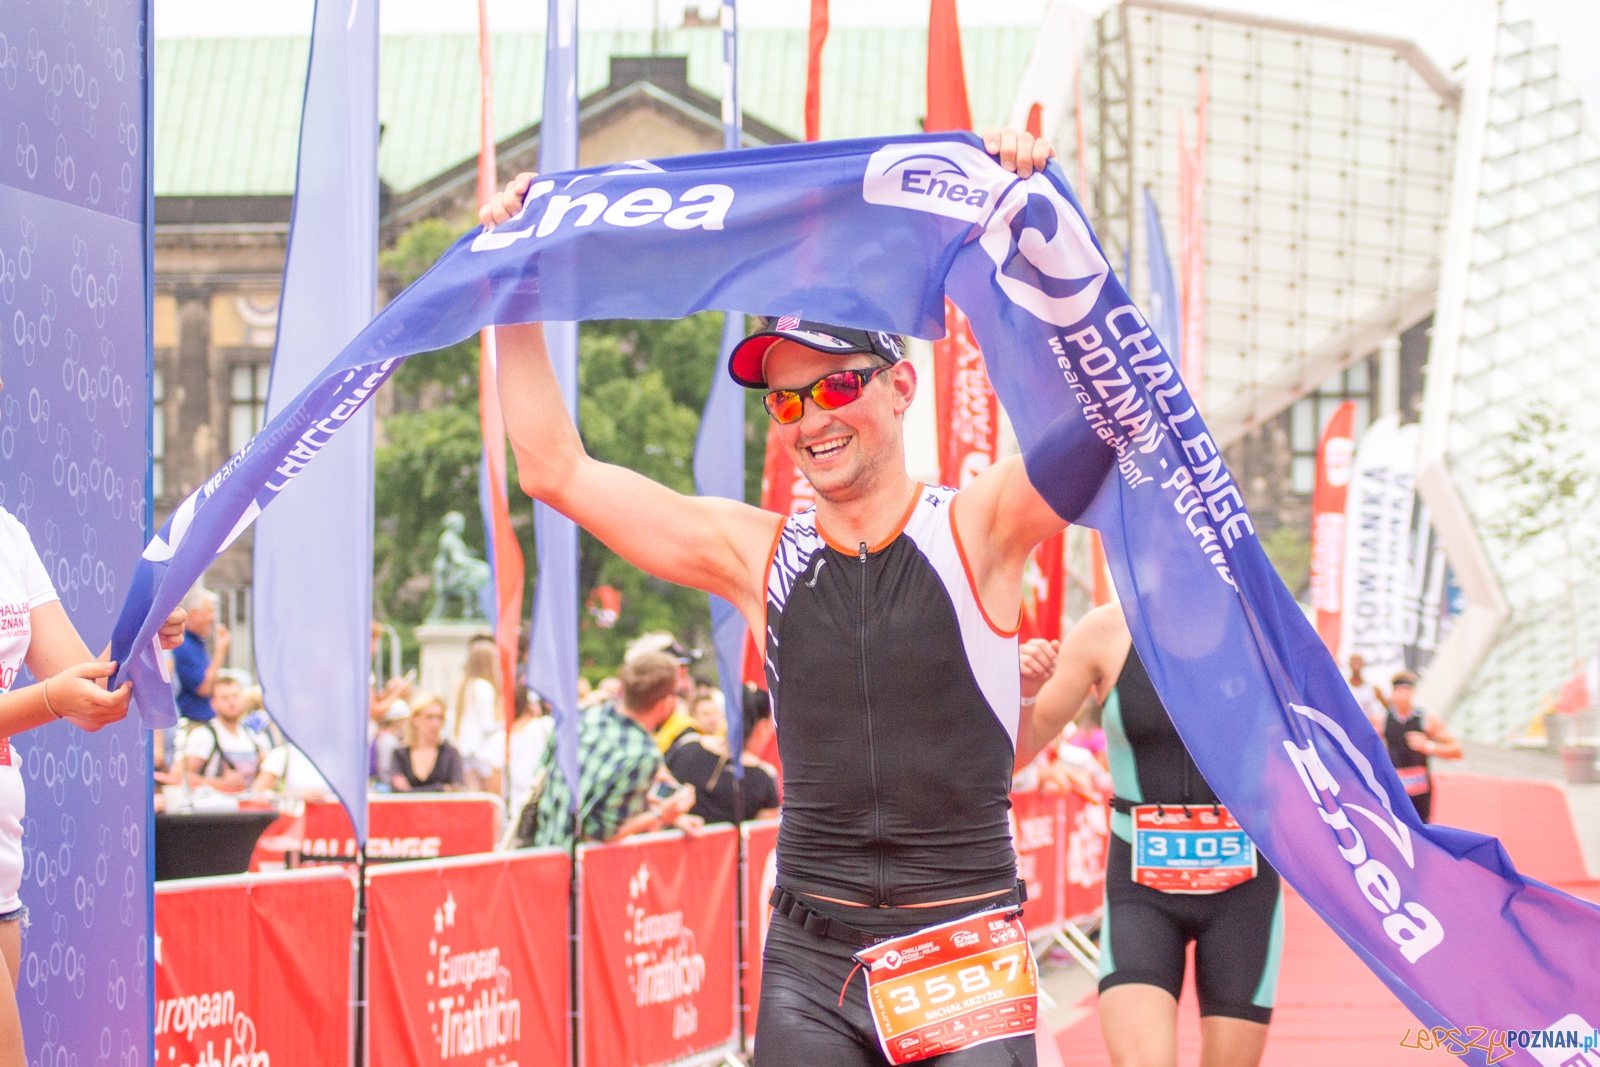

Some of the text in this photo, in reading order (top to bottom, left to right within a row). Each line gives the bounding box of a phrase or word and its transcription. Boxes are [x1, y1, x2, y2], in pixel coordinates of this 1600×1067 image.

[471, 180, 735, 252] Enea
[901, 169, 989, 208] Enea
[1065, 325, 1169, 454] POZNAŃ
[1105, 304, 1255, 549] CHALLENGE
[1148, 835, 1241, 858] 3105
[1283, 739, 1445, 964] Enea
[901, 941, 934, 956] CHALLENGE
[954, 932, 979, 944] Enea
[438, 945, 500, 992] European
[634, 945, 706, 1007] Triathlon
[889, 953, 1020, 1015] 3587
[154, 989, 235, 1042] uropean
[438, 987, 521, 1060] Triathlon
[925, 1003, 963, 1021] MICHAŁ
[963, 988, 1006, 1009] KRZYŻEK
